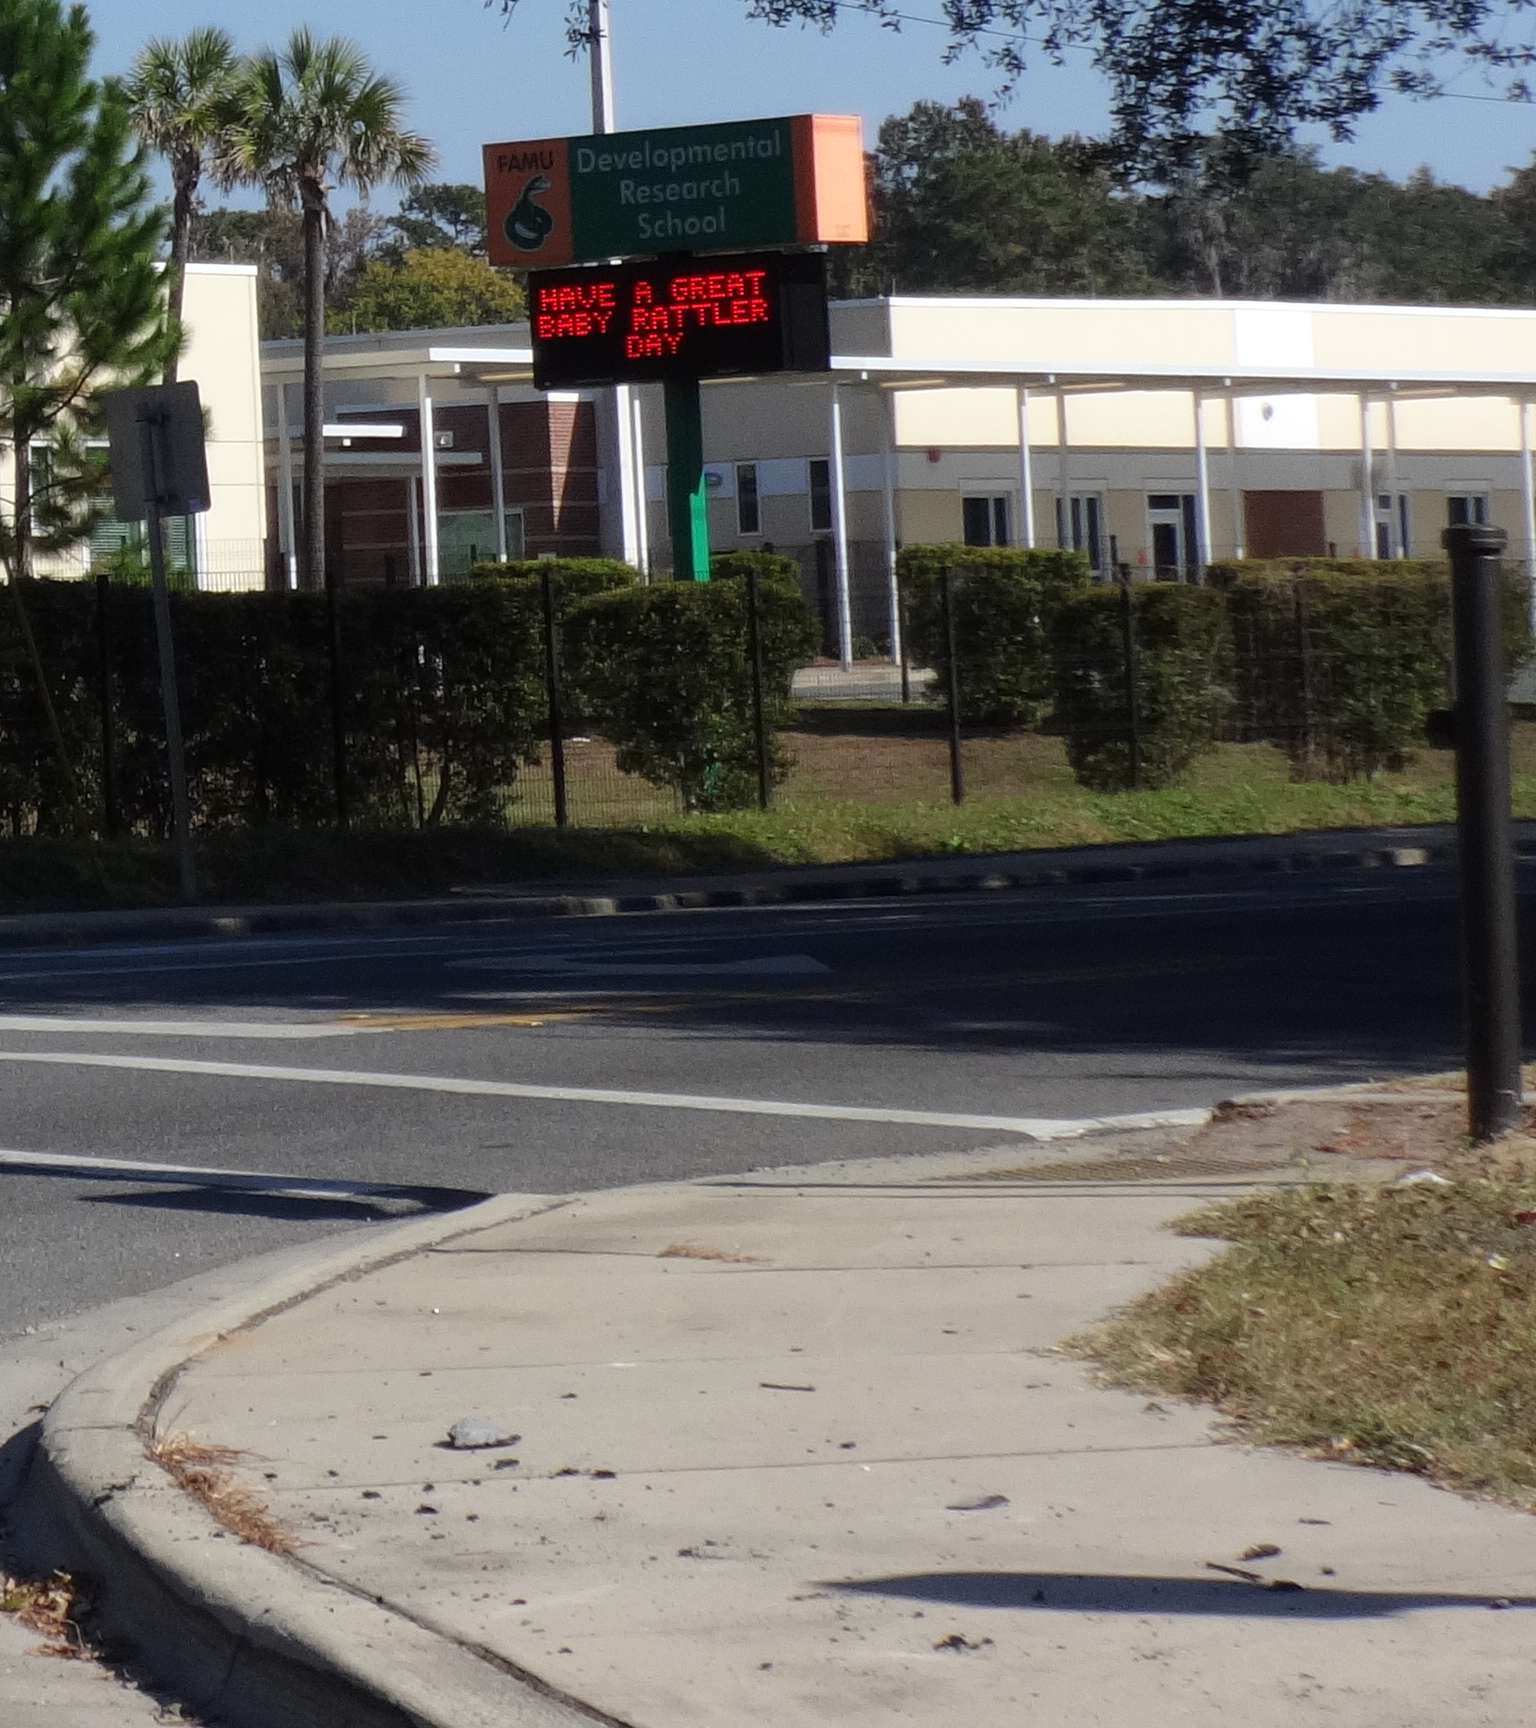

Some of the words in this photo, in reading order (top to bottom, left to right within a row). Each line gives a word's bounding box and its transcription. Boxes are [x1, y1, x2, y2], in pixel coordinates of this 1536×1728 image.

[497, 150, 554, 173] FAMU
[577, 129, 782, 174] Developmental
[619, 170, 741, 206] Research
[637, 204, 727, 240] School
[539, 282, 617, 313] HAVE
[634, 280, 653, 305] A
[670, 270, 767, 302] GREAT
[537, 309, 614, 339] BABY
[631, 297, 770, 332] RATTLER
[625, 331, 685, 359] DAY
